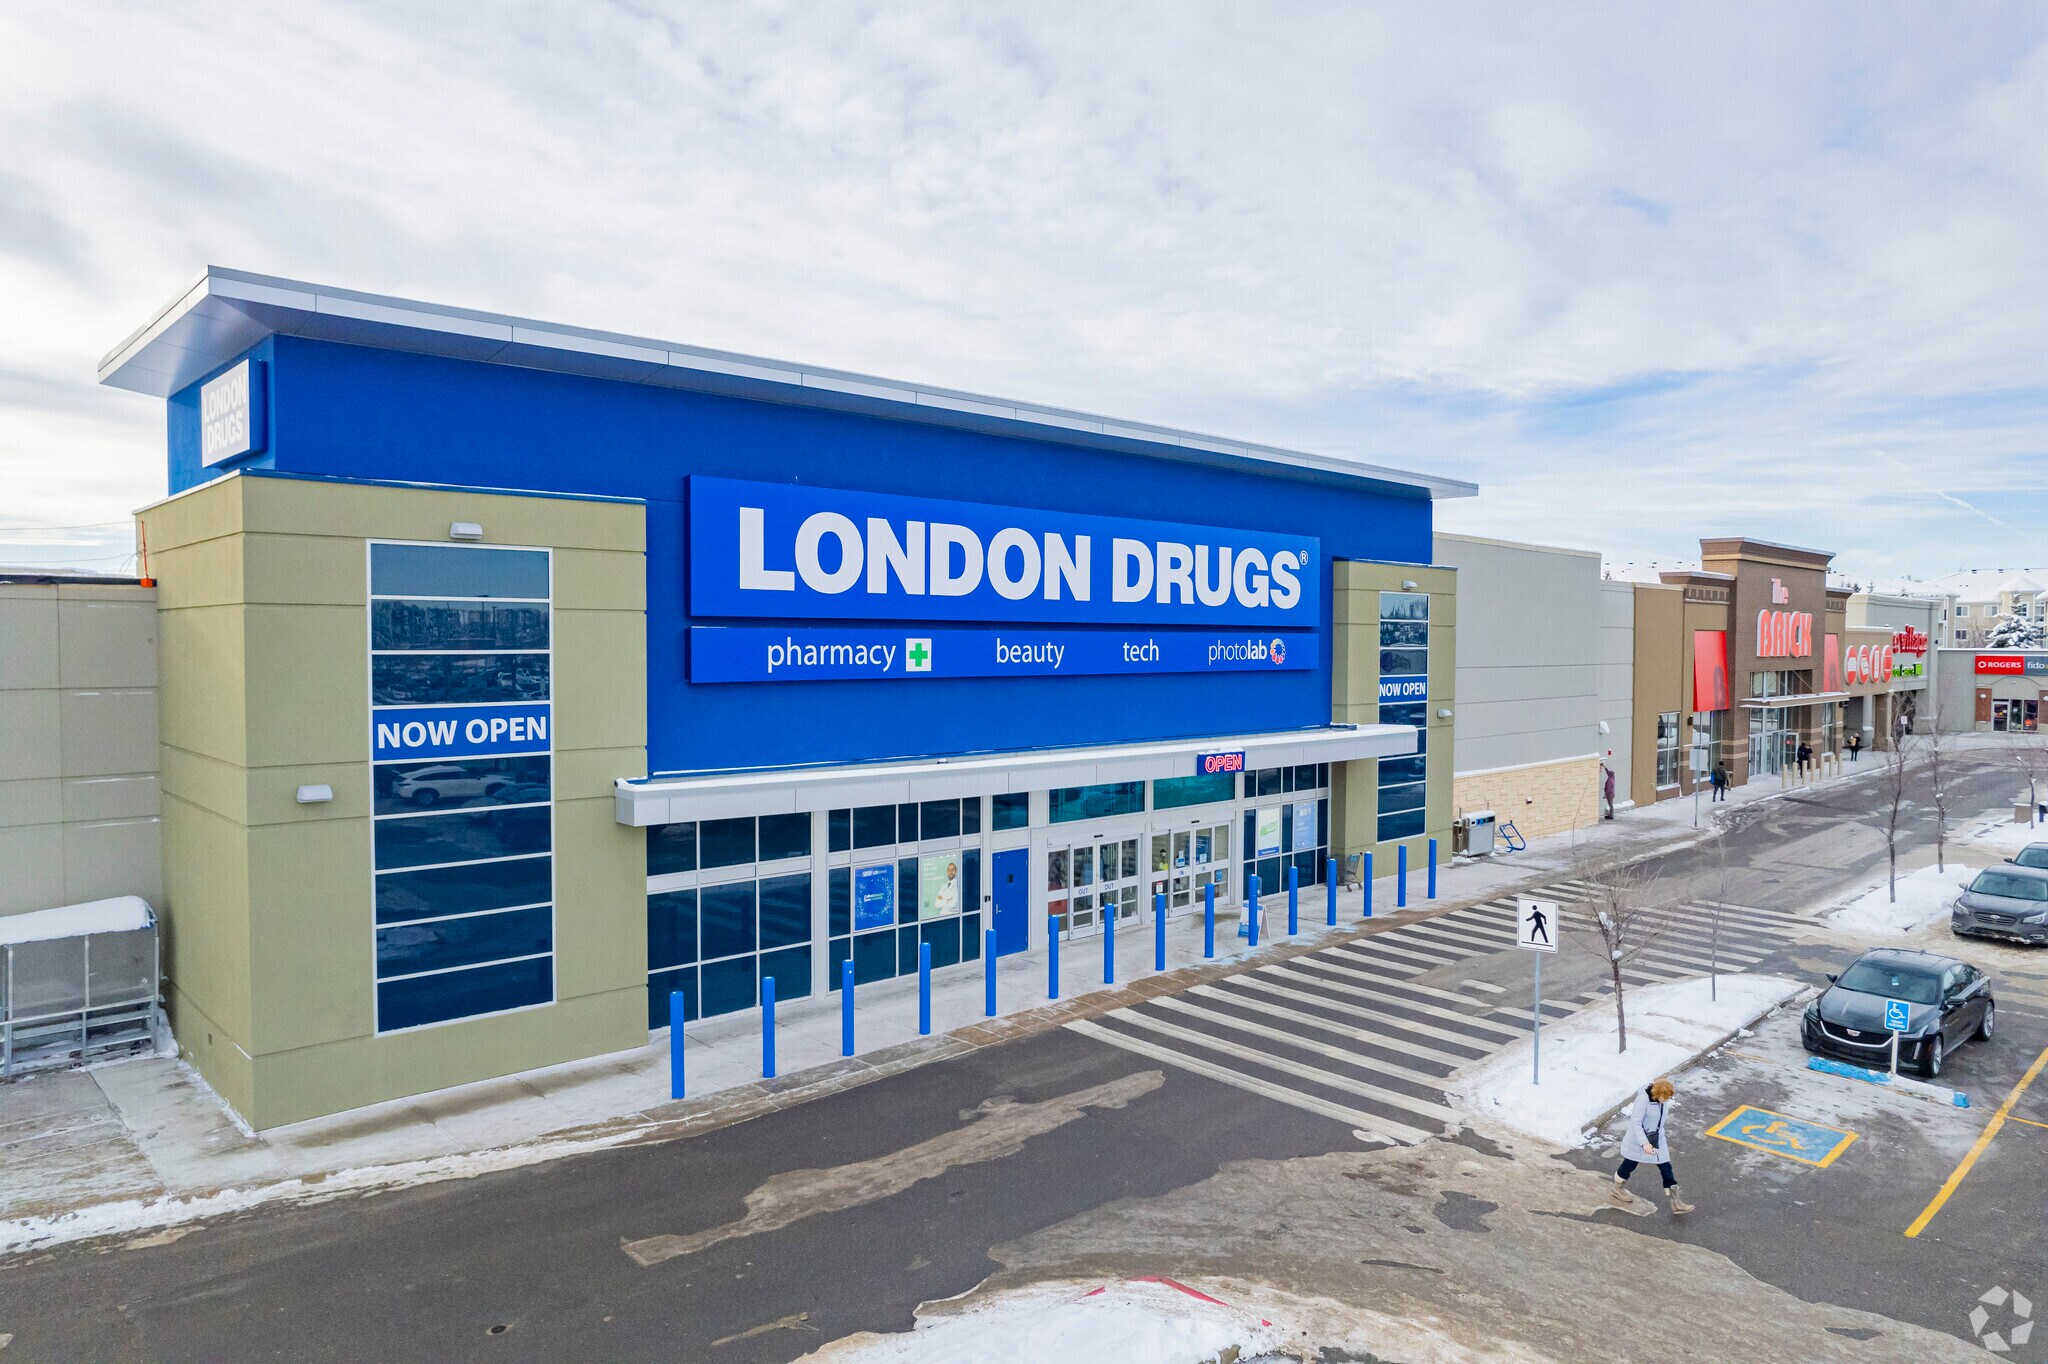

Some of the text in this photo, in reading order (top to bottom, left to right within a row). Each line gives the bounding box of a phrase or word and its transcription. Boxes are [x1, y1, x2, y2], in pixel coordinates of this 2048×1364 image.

[203, 373, 247, 423] LONDON
[738, 506, 1092, 602] LONDON
[1771, 577, 1789, 605] The
[1757, 609, 1812, 657] BRICK
[767, 636, 897, 674] pharmacy
[996, 637, 1065, 670] beauty
[1122, 638, 1160, 662] tech
[1208, 639, 1268, 666] photolab
[1987, 661, 2022, 669] ROGERS
[2027, 661, 2046, 669] fido
[1379, 681, 1426, 697] NOW OPEN
[377, 716, 547, 749] NOW OPEN
[1204, 753, 1243, 774] OPEN
[1078, 887, 1088, 896] OUT
[1103, 882, 1114, 891] OUT
